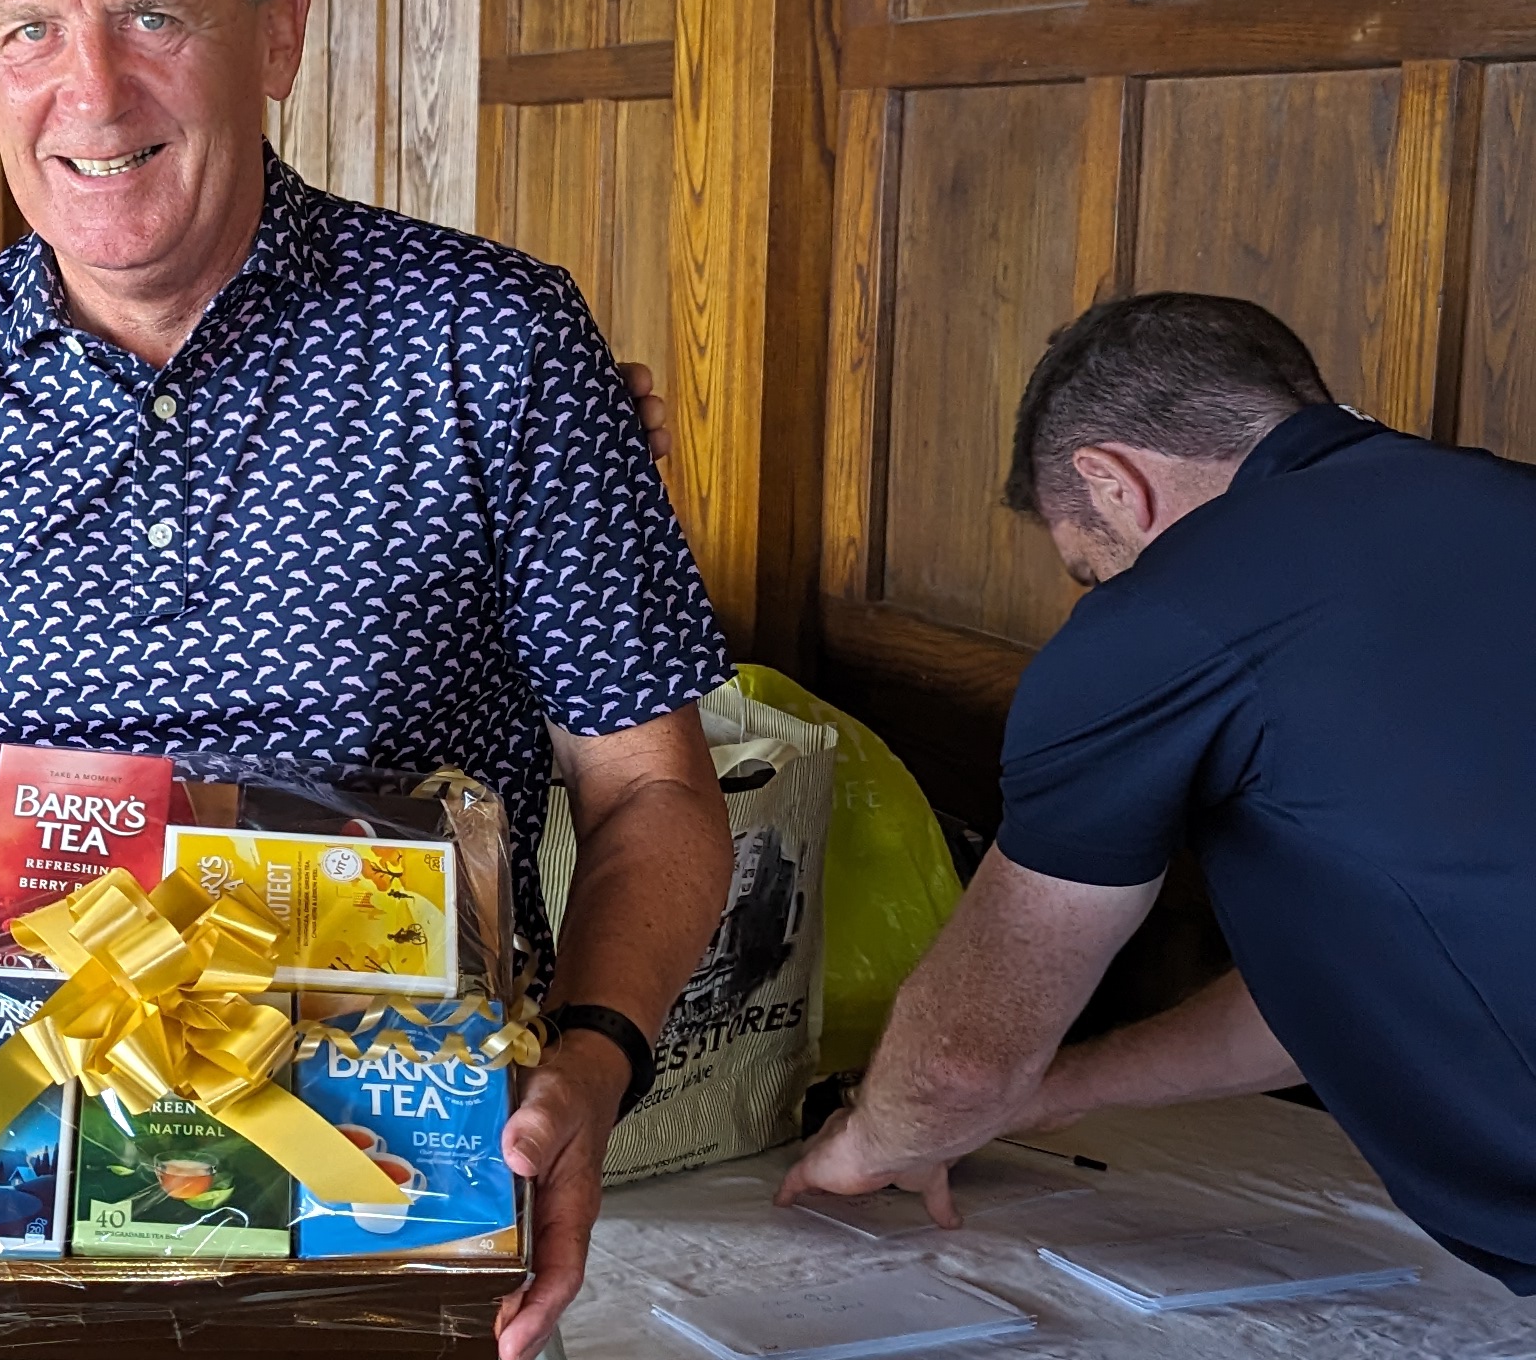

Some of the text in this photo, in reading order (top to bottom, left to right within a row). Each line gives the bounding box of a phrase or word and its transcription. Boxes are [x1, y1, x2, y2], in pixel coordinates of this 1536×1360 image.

[50, 770, 71, 779] TAKE
[83, 774, 123, 784] MOMENT
[14, 784, 146, 836] BARRY'S
[36, 821, 109, 856] TEA
[25, 858, 119, 876] REFRESHIN
[333, 860, 347, 875] VIT
[19, 878, 68, 891] BERRY
[151, 1101, 197, 1114] REEN
[361, 1083, 451, 1120] TEA
[149, 1123, 225, 1137] NATURAL
[413, 1131, 482, 1150] DECAF
[96, 1210, 126, 1228] 40
[479, 1239, 495, 1250] 40
